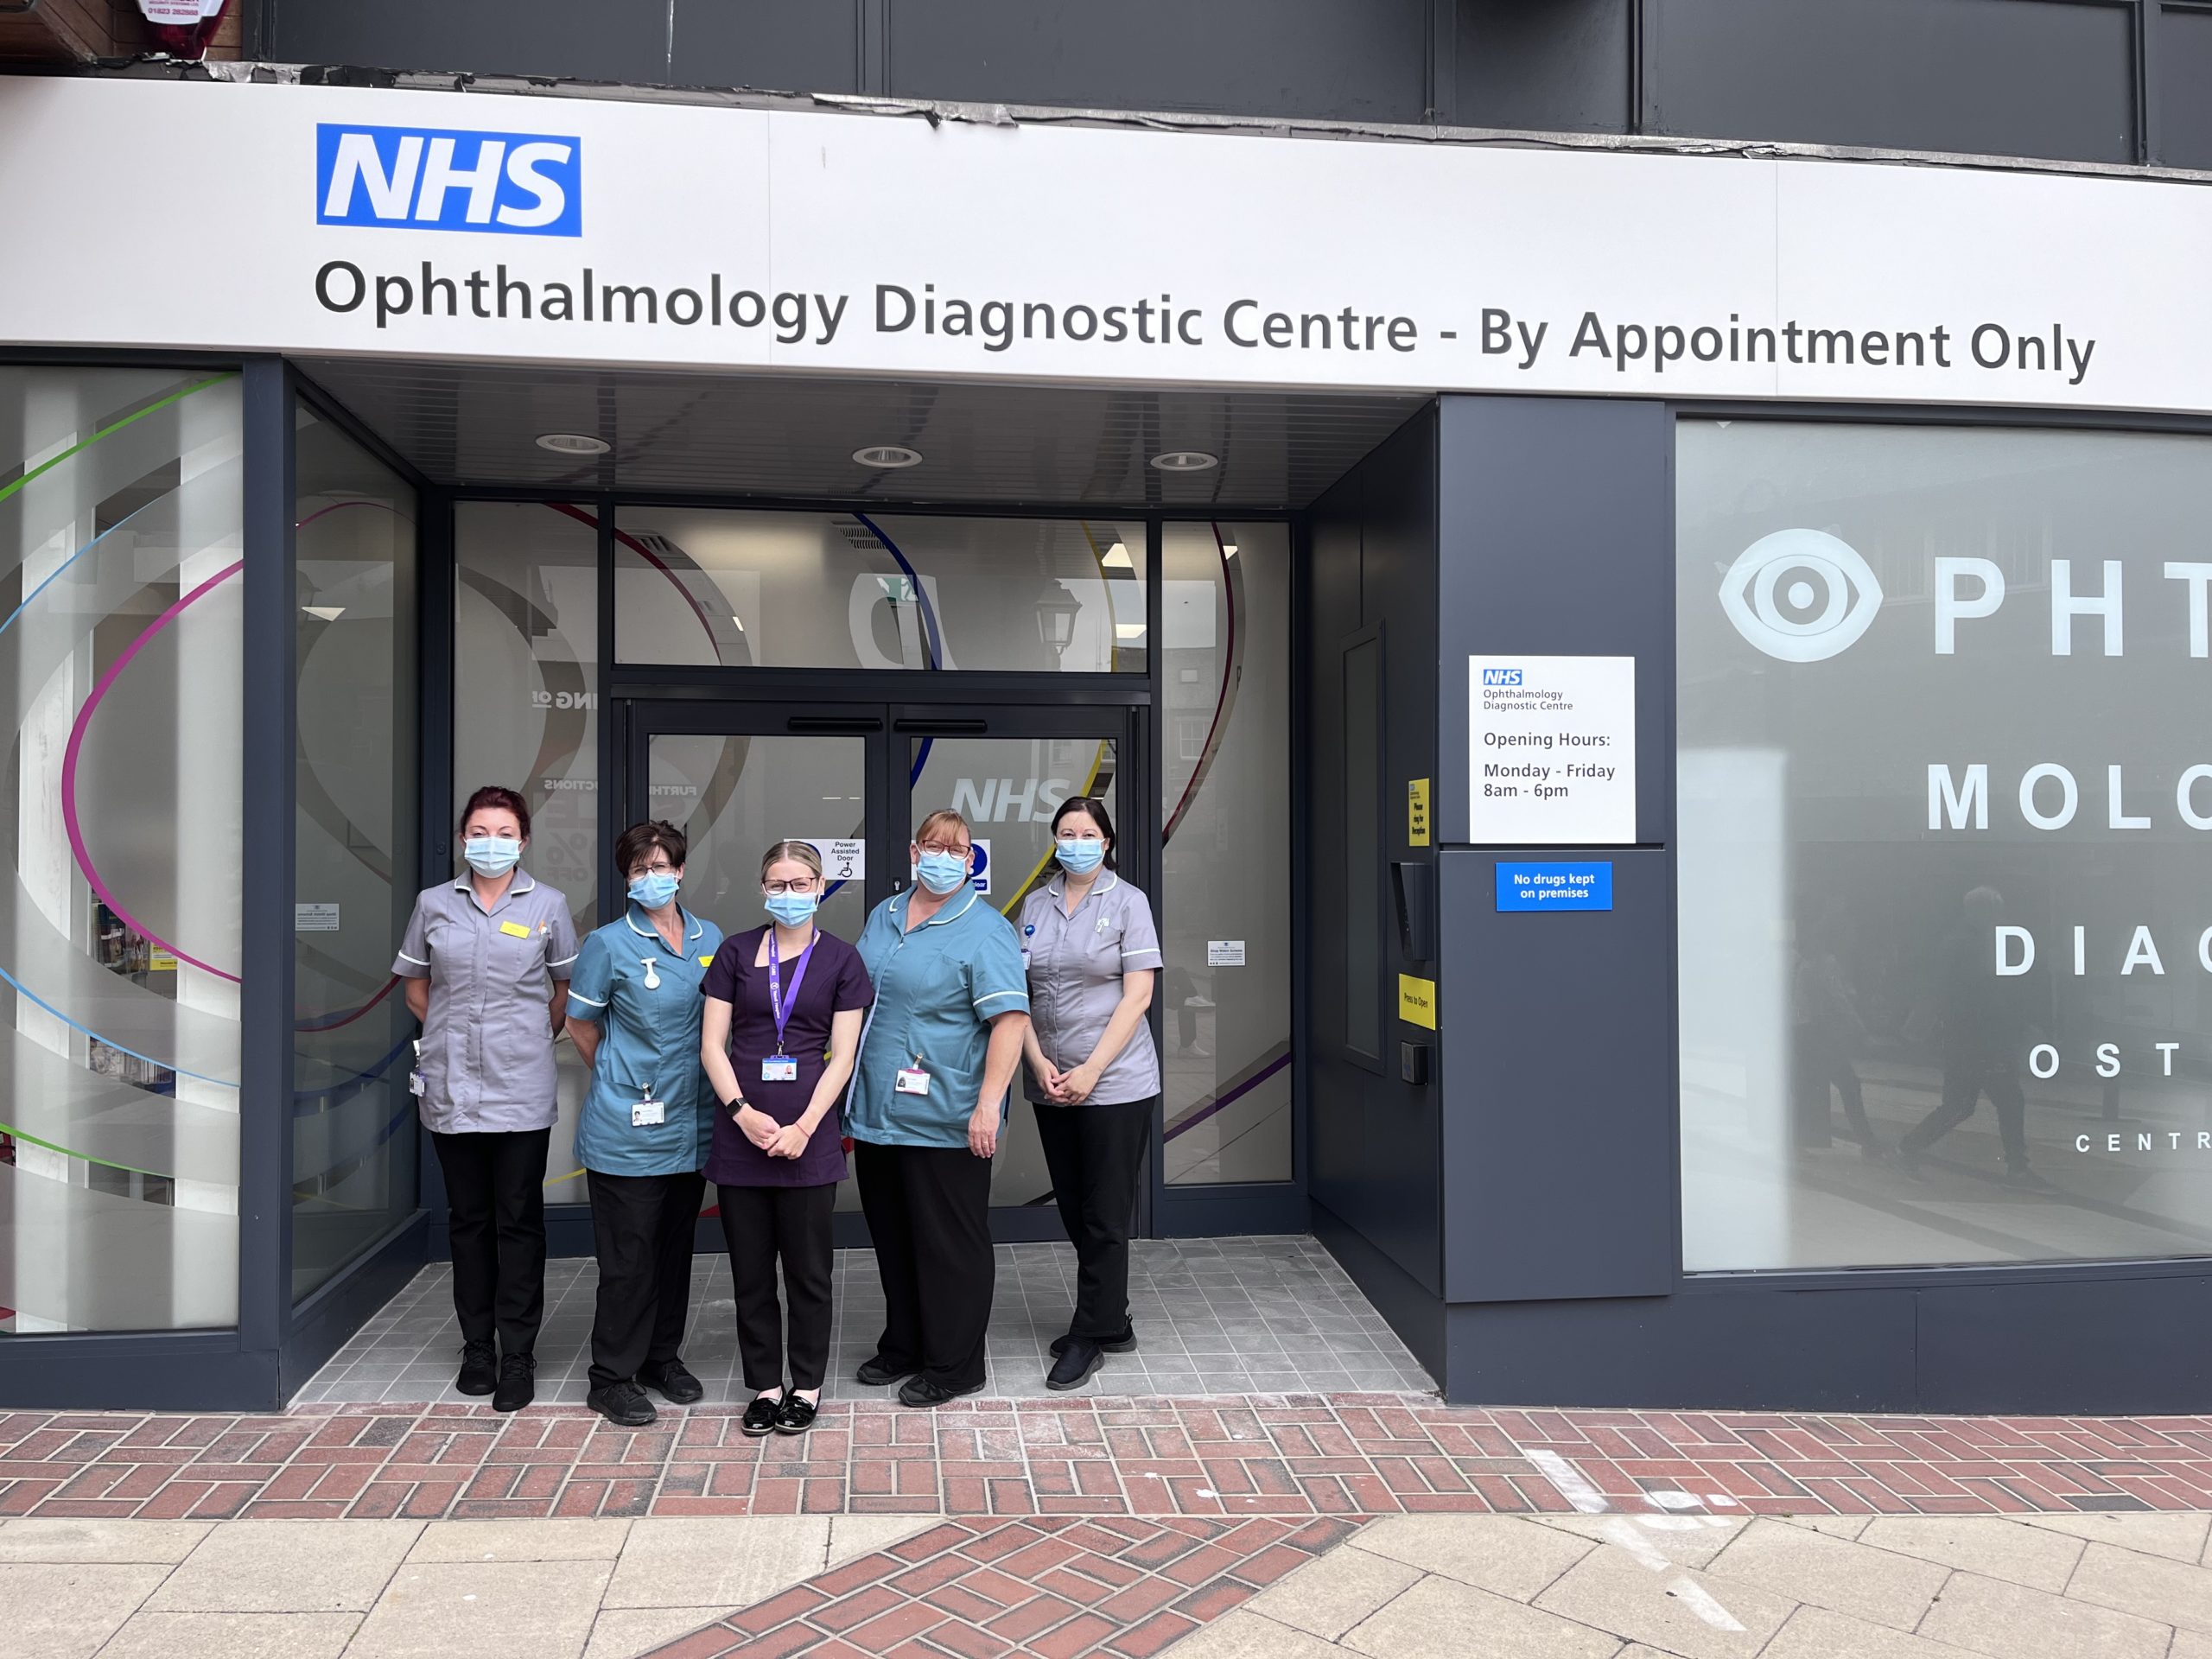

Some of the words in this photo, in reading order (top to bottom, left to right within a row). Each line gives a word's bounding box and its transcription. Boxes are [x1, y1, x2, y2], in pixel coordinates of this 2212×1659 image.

[324, 133, 571, 227] NHS
[315, 261, 849, 345] Ophthalmology
[876, 284, 1202, 352] Diagnostic
[1224, 300, 1417, 352] Centre
[1482, 308, 1548, 369] By
[1569, 312, 1950, 372] Appointment
[1972, 323, 2095, 385] Only
[1484, 670, 1521, 684] NHS
[1484, 690, 1563, 701] Ophthalmology
[1484, 701, 1537, 712] Diagnostic
[1540, 701, 1573, 710] Centre
[1484, 732, 1553, 749] Opening
[1559, 733, 1611, 746] Hours:
[1484, 763, 1550, 780] Monday
[1567, 763, 1616, 780] Friday
[1484, 784, 1517, 797] 8am
[1534, 784, 1568, 800] 6pm
[950, 779, 1071, 823] NHS
[1514, 874, 1530, 884] No
[1534, 874, 1566, 887] drugs
[1569, 874, 1594, 886] kept
[1539, 887, 1588, 900] premises
